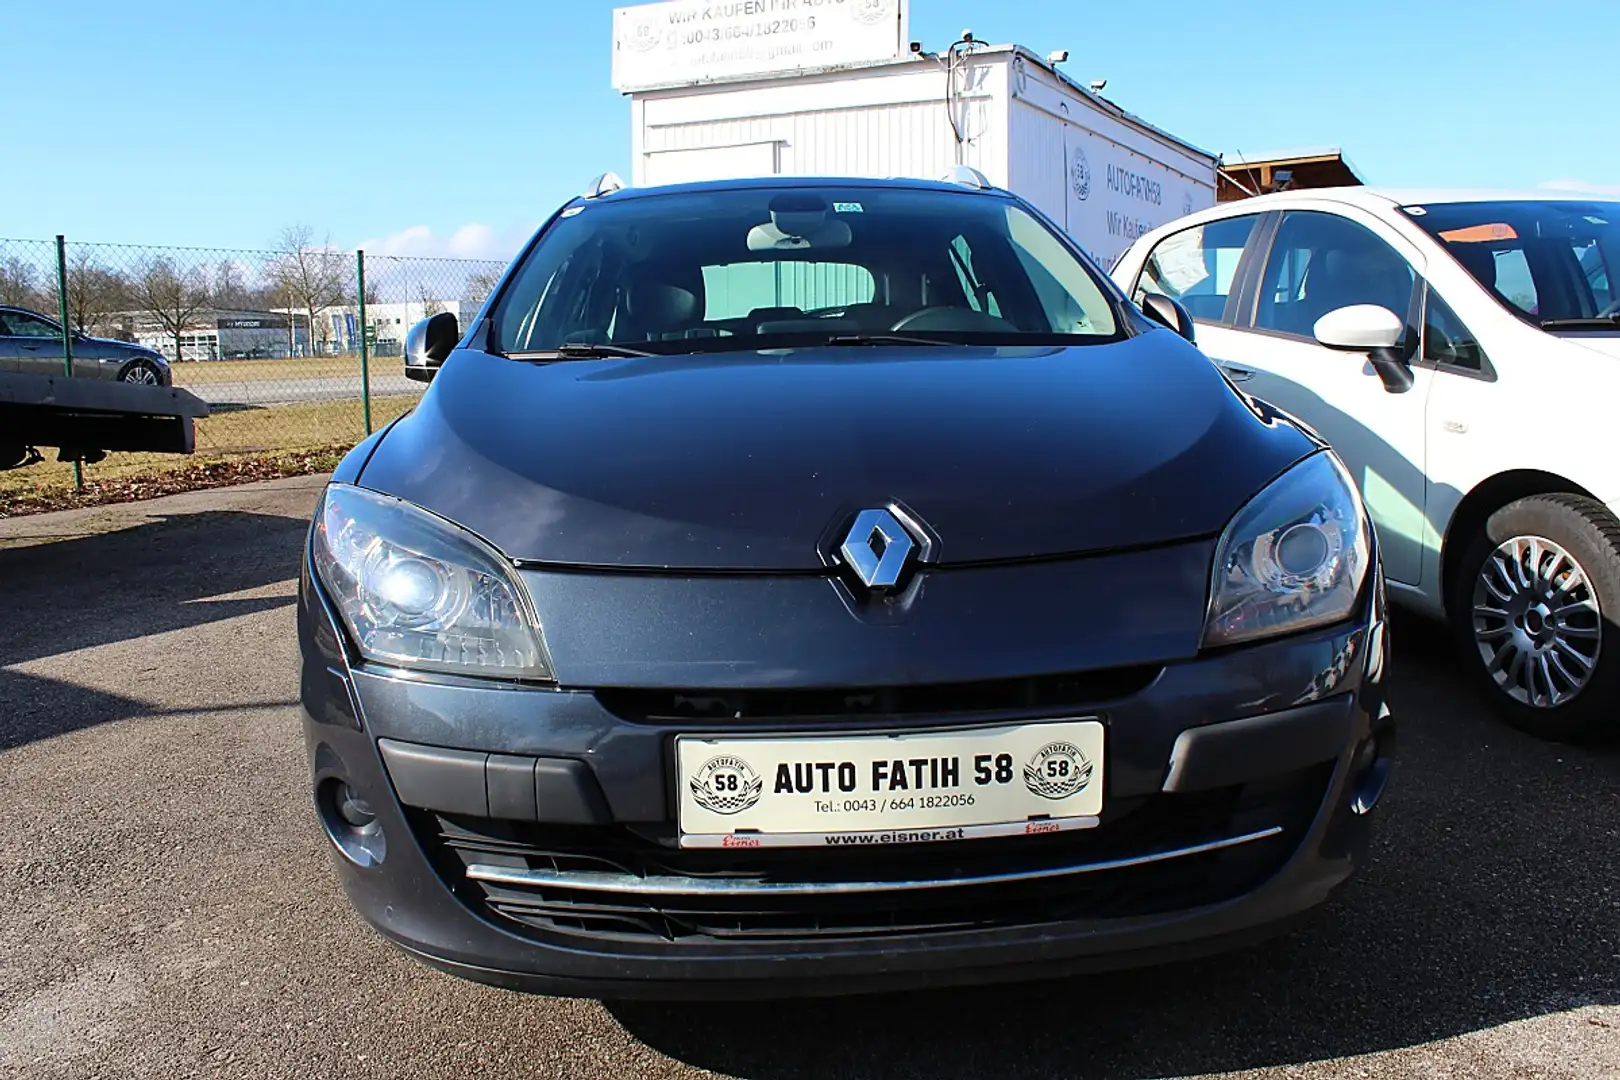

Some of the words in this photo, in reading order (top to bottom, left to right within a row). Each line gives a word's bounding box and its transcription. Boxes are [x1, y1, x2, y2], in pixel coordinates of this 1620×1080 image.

[669, 10, 699, 25] WIR
[702, 0, 767, 21] KAUFEN
[1106, 210, 1122, 236] Wir
[1040, 745, 1077, 758] AUTOFATIH
[774, 762, 856, 794] AUTO
[872, 757, 959, 791] FATIH
[974, 753, 1013, 785] 58
[1047, 760, 1069, 777] 58
[715, 774, 738, 791] 58
[814, 800, 841, 812] Tel.:
[843, 799, 877, 811] 0043
[889, 797, 914, 810] 664
[919, 794, 975, 809] 1822056
[825, 827, 964, 845] www.eisner.at
